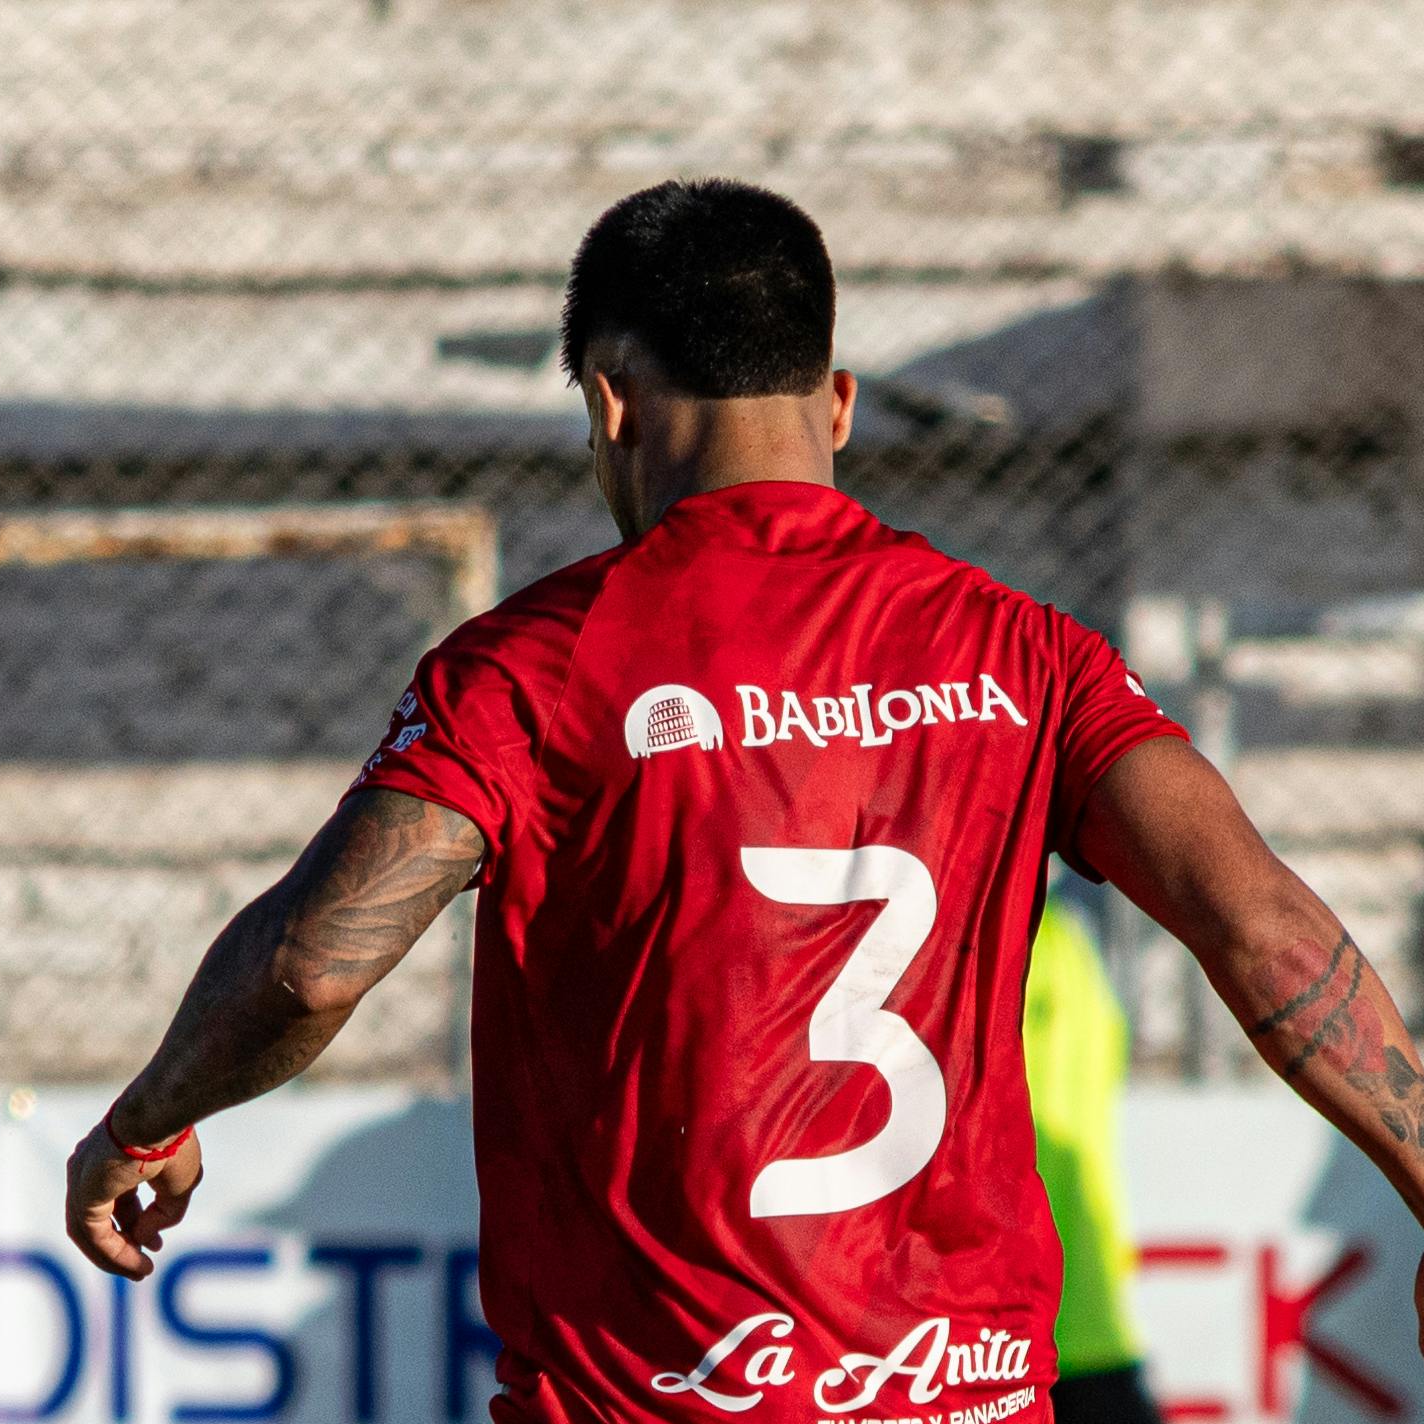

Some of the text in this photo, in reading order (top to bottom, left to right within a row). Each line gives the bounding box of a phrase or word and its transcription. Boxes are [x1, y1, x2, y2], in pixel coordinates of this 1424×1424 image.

[735, 674, 1029, 748] BABILONIA
[740, 844, 947, 1218] 3
[651, 1312, 1032, 1414] La Anita
